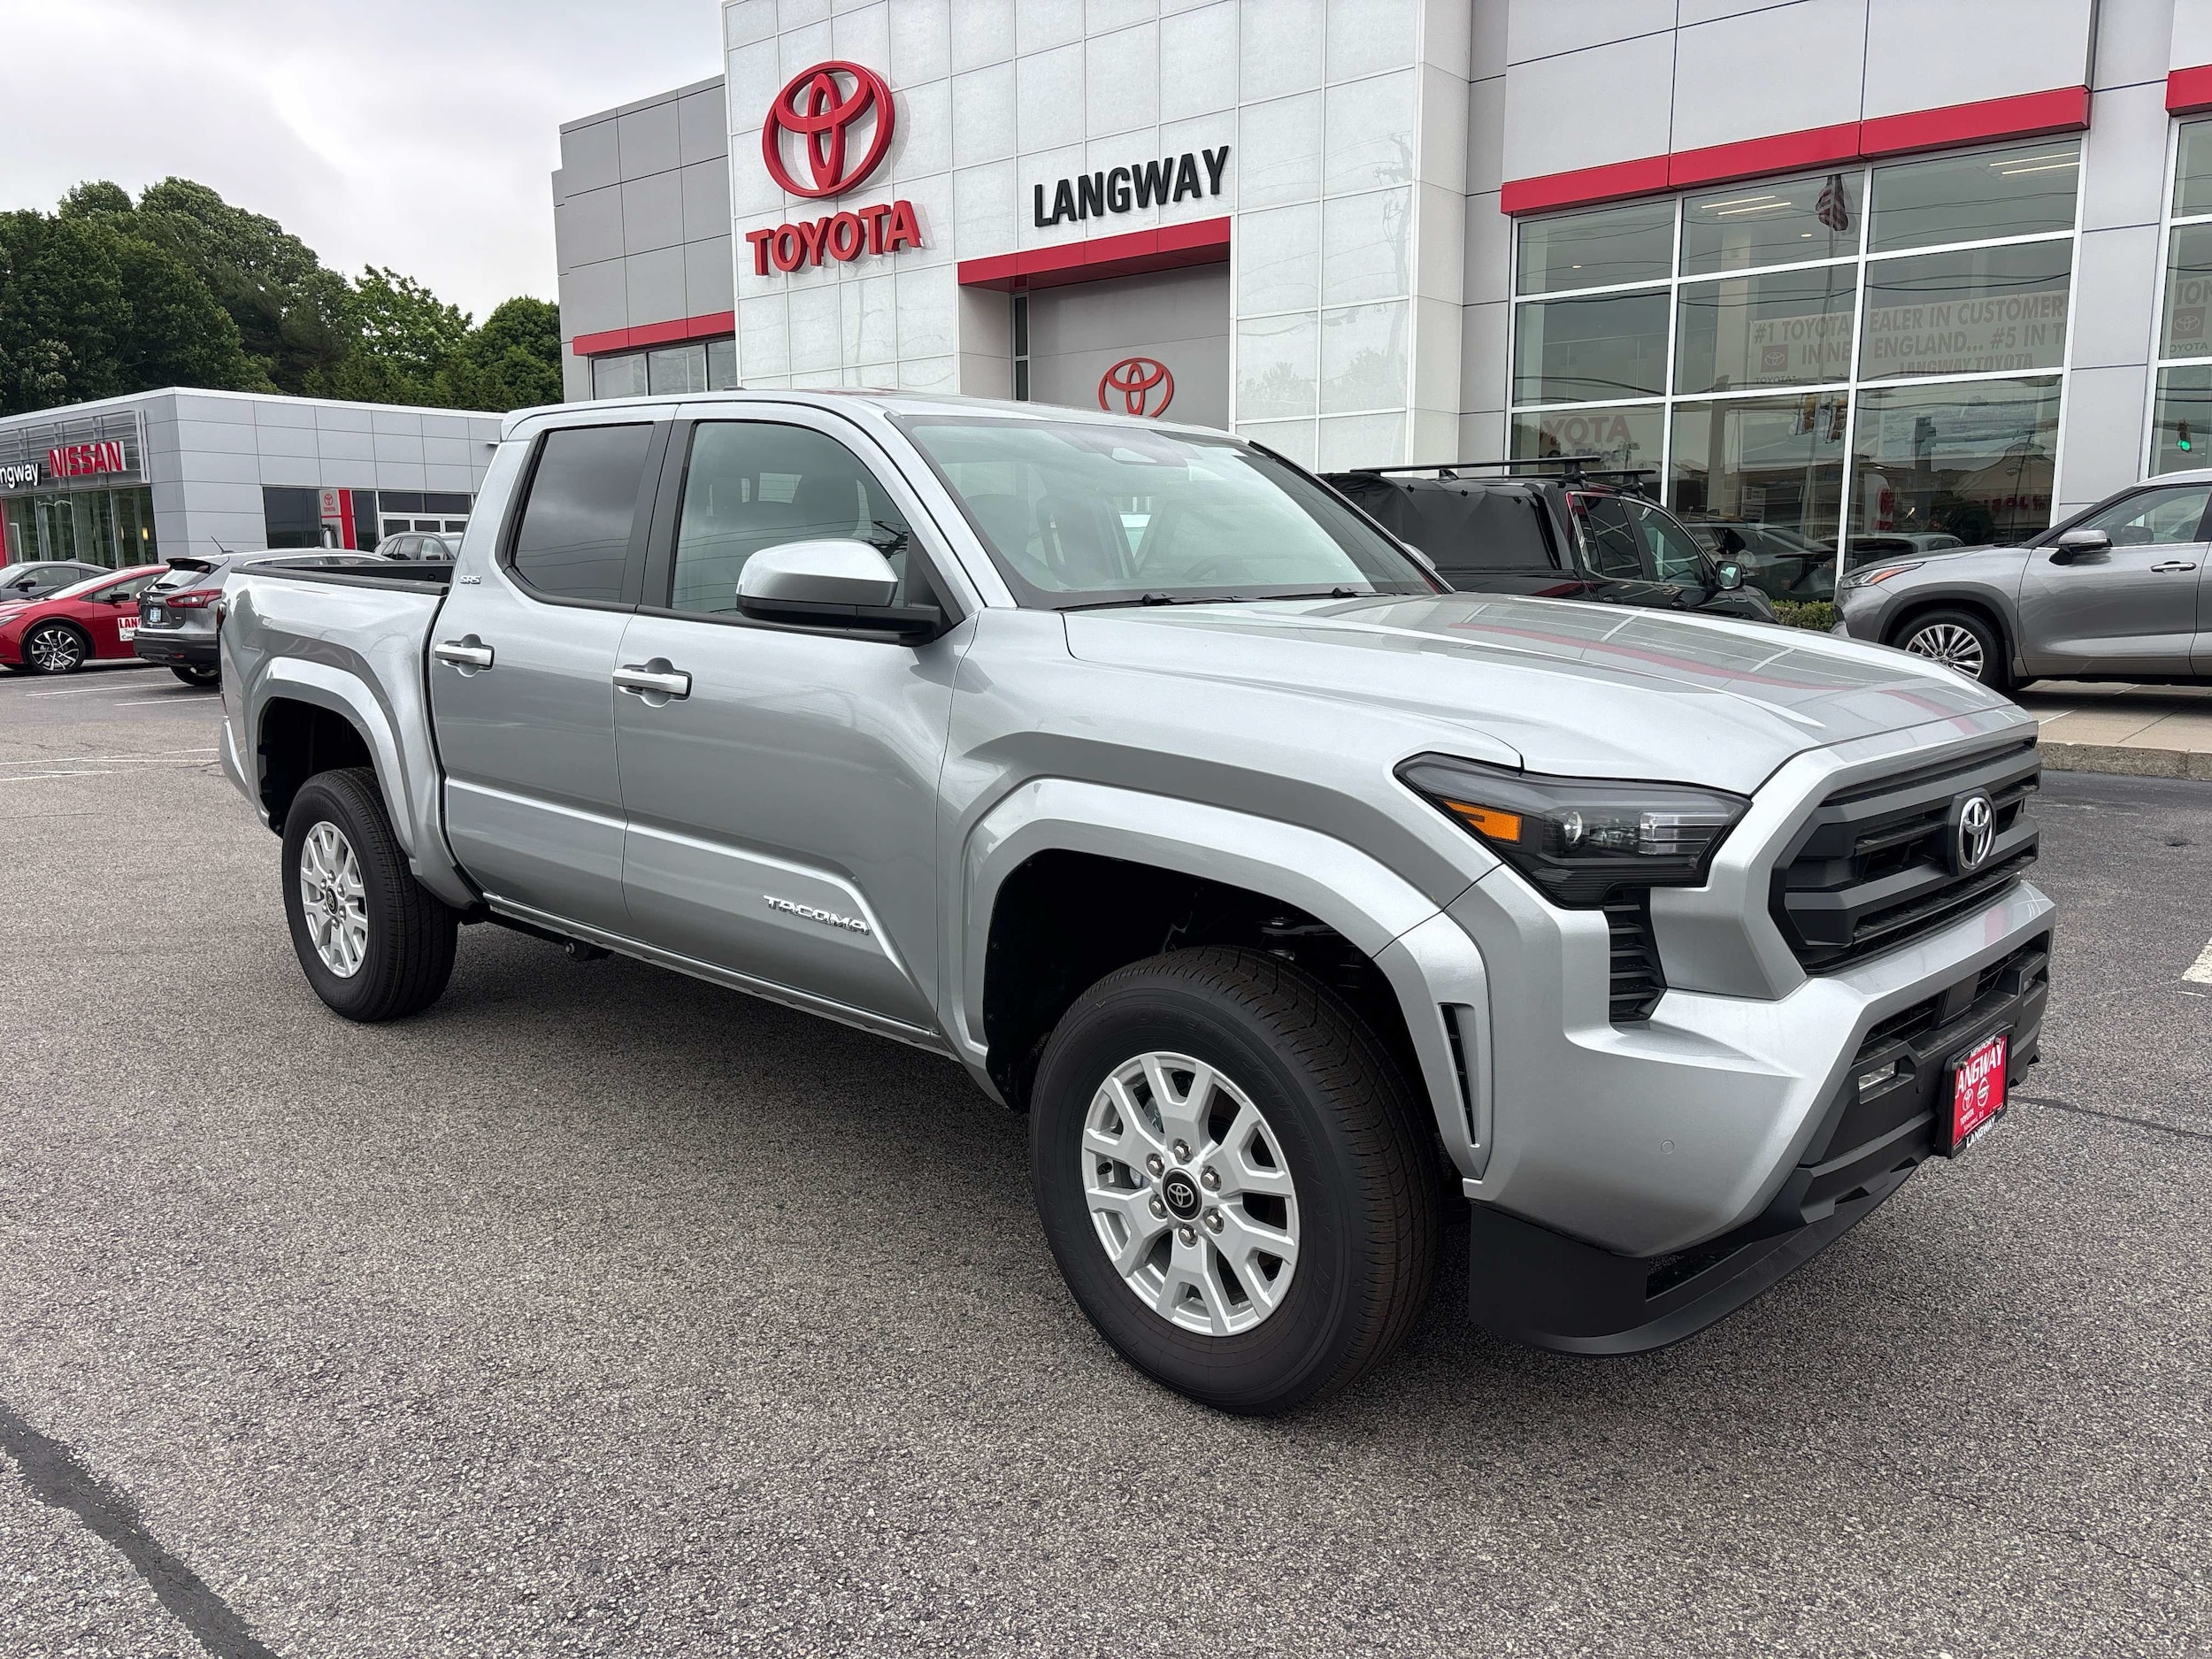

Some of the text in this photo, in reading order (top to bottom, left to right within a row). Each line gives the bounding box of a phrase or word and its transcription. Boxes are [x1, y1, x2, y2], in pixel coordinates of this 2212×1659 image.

[1034, 145, 1229, 227] LANGWAY
[746, 200, 923, 275] TOYOTA
[1755, 296, 2063, 344] #1 TOYOTA EALER IN CUSTOMER
[1801, 343, 1821, 365] IN
[1826, 340, 1851, 363] NE
[1990, 326, 2017, 350] #5
[2024, 323, 2046, 348] IN
[2170, 342, 2208, 353] OYOTA
[1900, 352, 2033, 379] LANGWAY TOYOTA
[49, 441, 125, 478] NISSAN
[119, 618, 140, 629] LAN
[763, 895, 871, 935] TACOMA
[1966, 1116, 1996, 1148] LANGWAY
